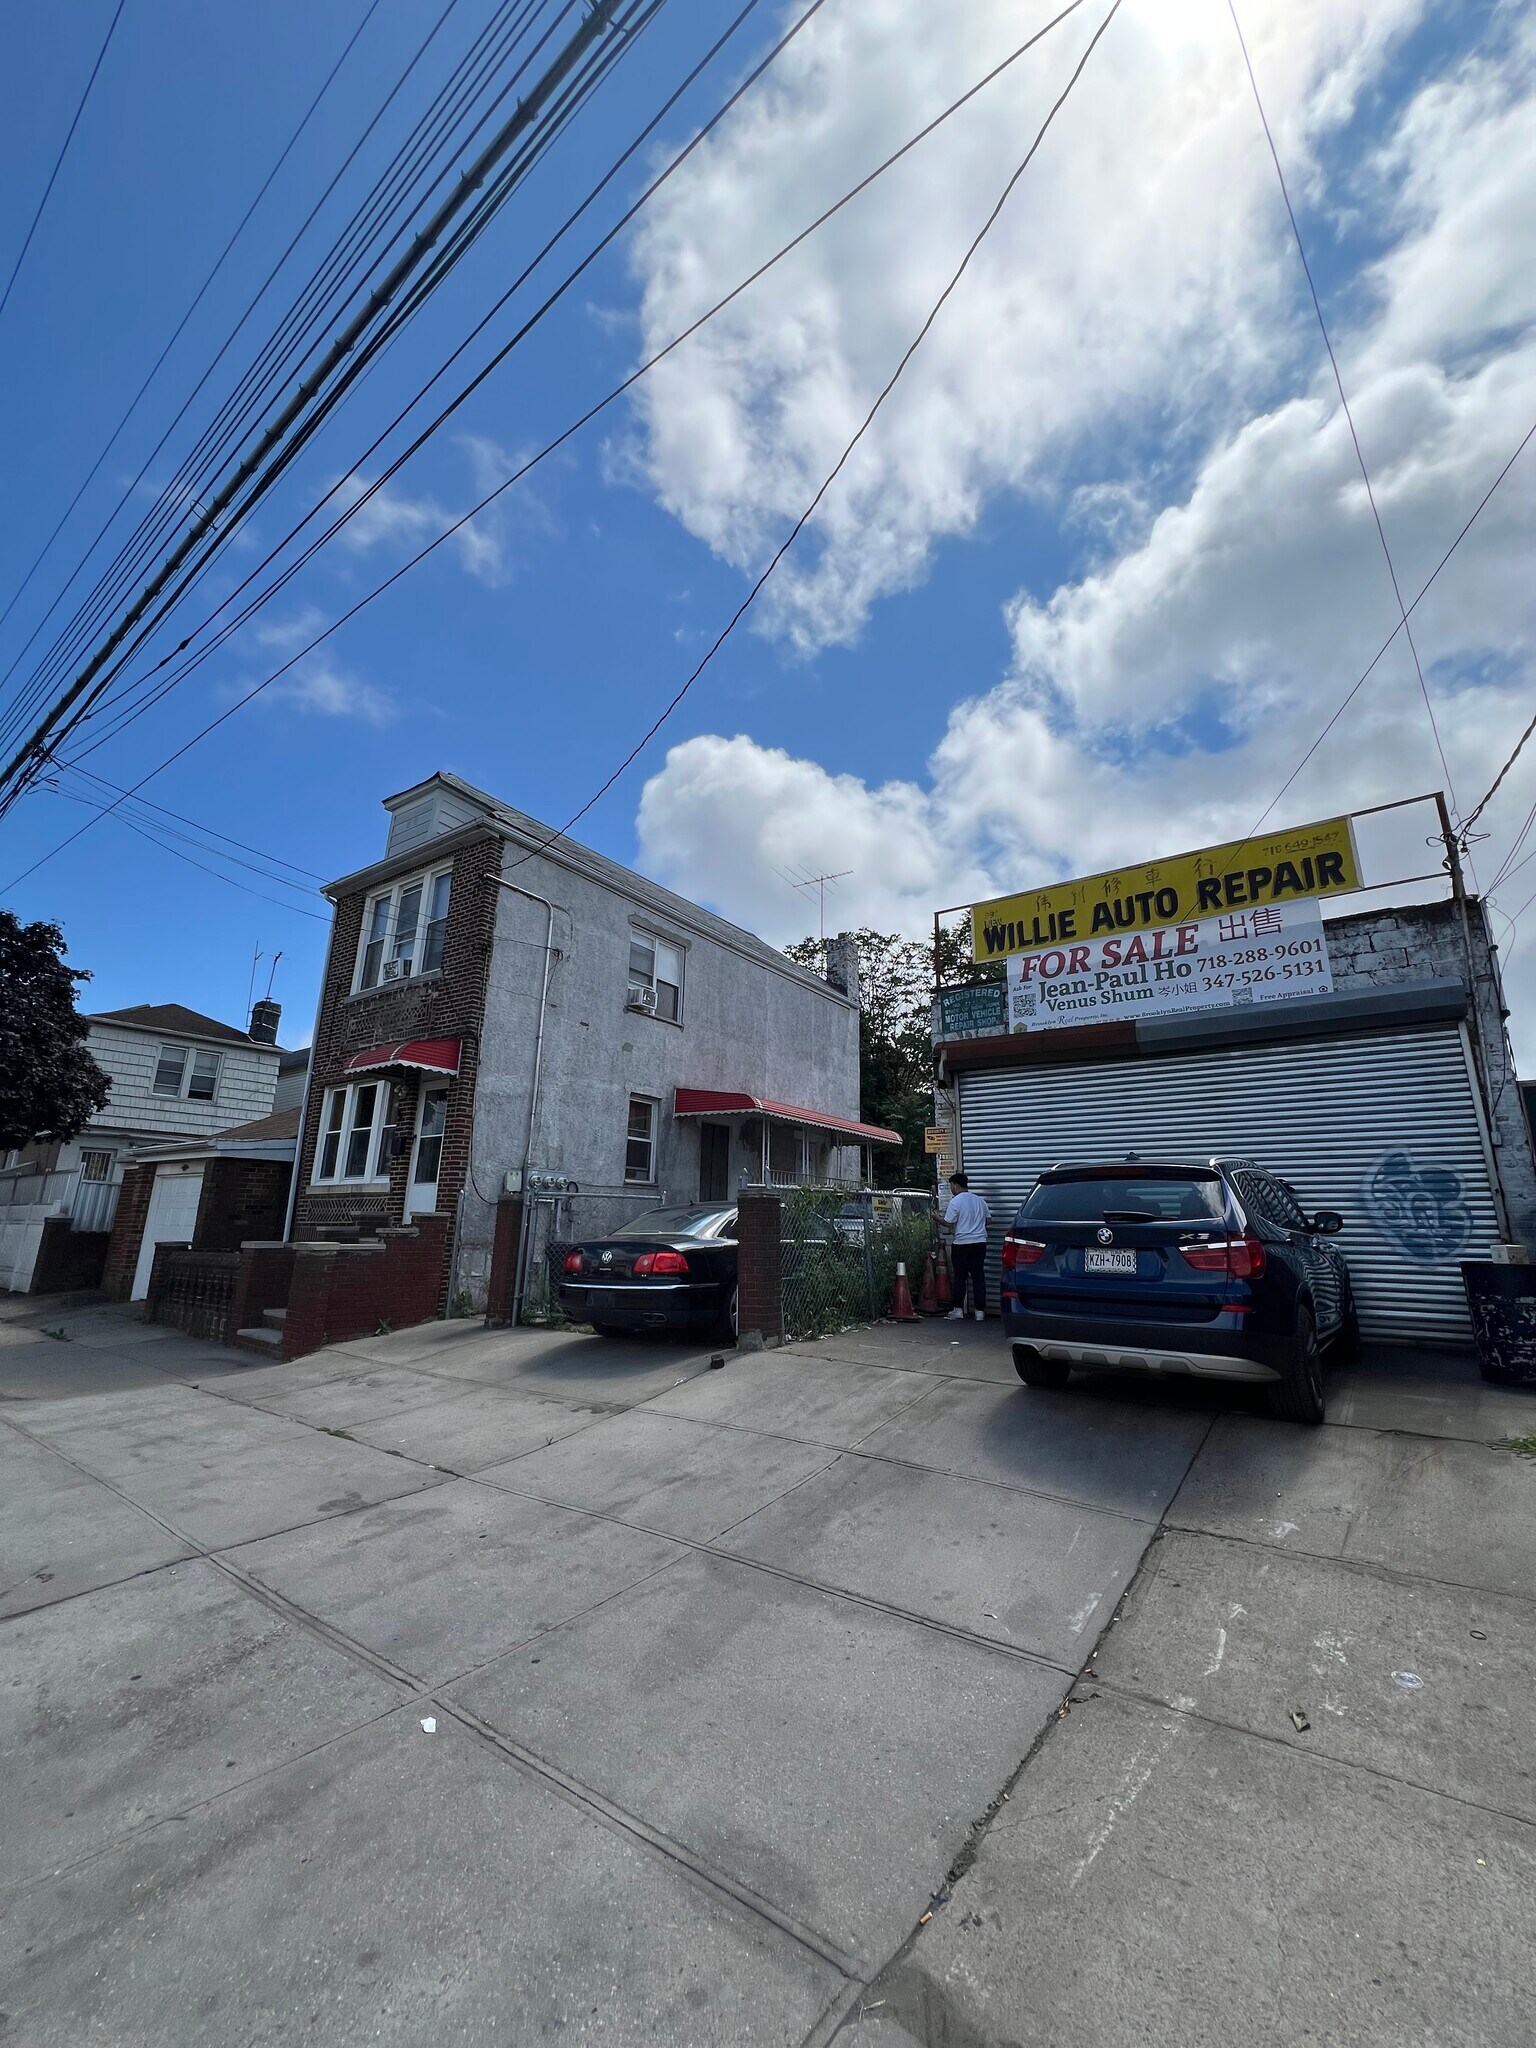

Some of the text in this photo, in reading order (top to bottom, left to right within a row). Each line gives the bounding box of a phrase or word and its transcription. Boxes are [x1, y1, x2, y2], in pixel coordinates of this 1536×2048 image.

[983, 852, 1346, 954] WILLIE AUTO REPAIR
[1218, 908, 1283, 942] 出售
[1020, 924, 1199, 983] FOR SALE
[1197, 938, 1323, 972] 718-288-9601
[1039, 960, 1192, 1003] Jean-Paul Ho
[1203, 959, 1325, 991] 347-526-5131
[943, 988, 1000, 1007] REGISTERED
[1046, 987, 1154, 1012] Venus Shum
[1158, 982, 1197, 997] 岑小姐
[1259, 988, 1314, 1001] Free Appraisal
[945, 1007, 1001, 1023] MOTOR VEHICLE
[1123, 1001, 1230, 1020] www.BrooklynRealProperty.com
[950, 1020, 974, 1031] REPAIR
